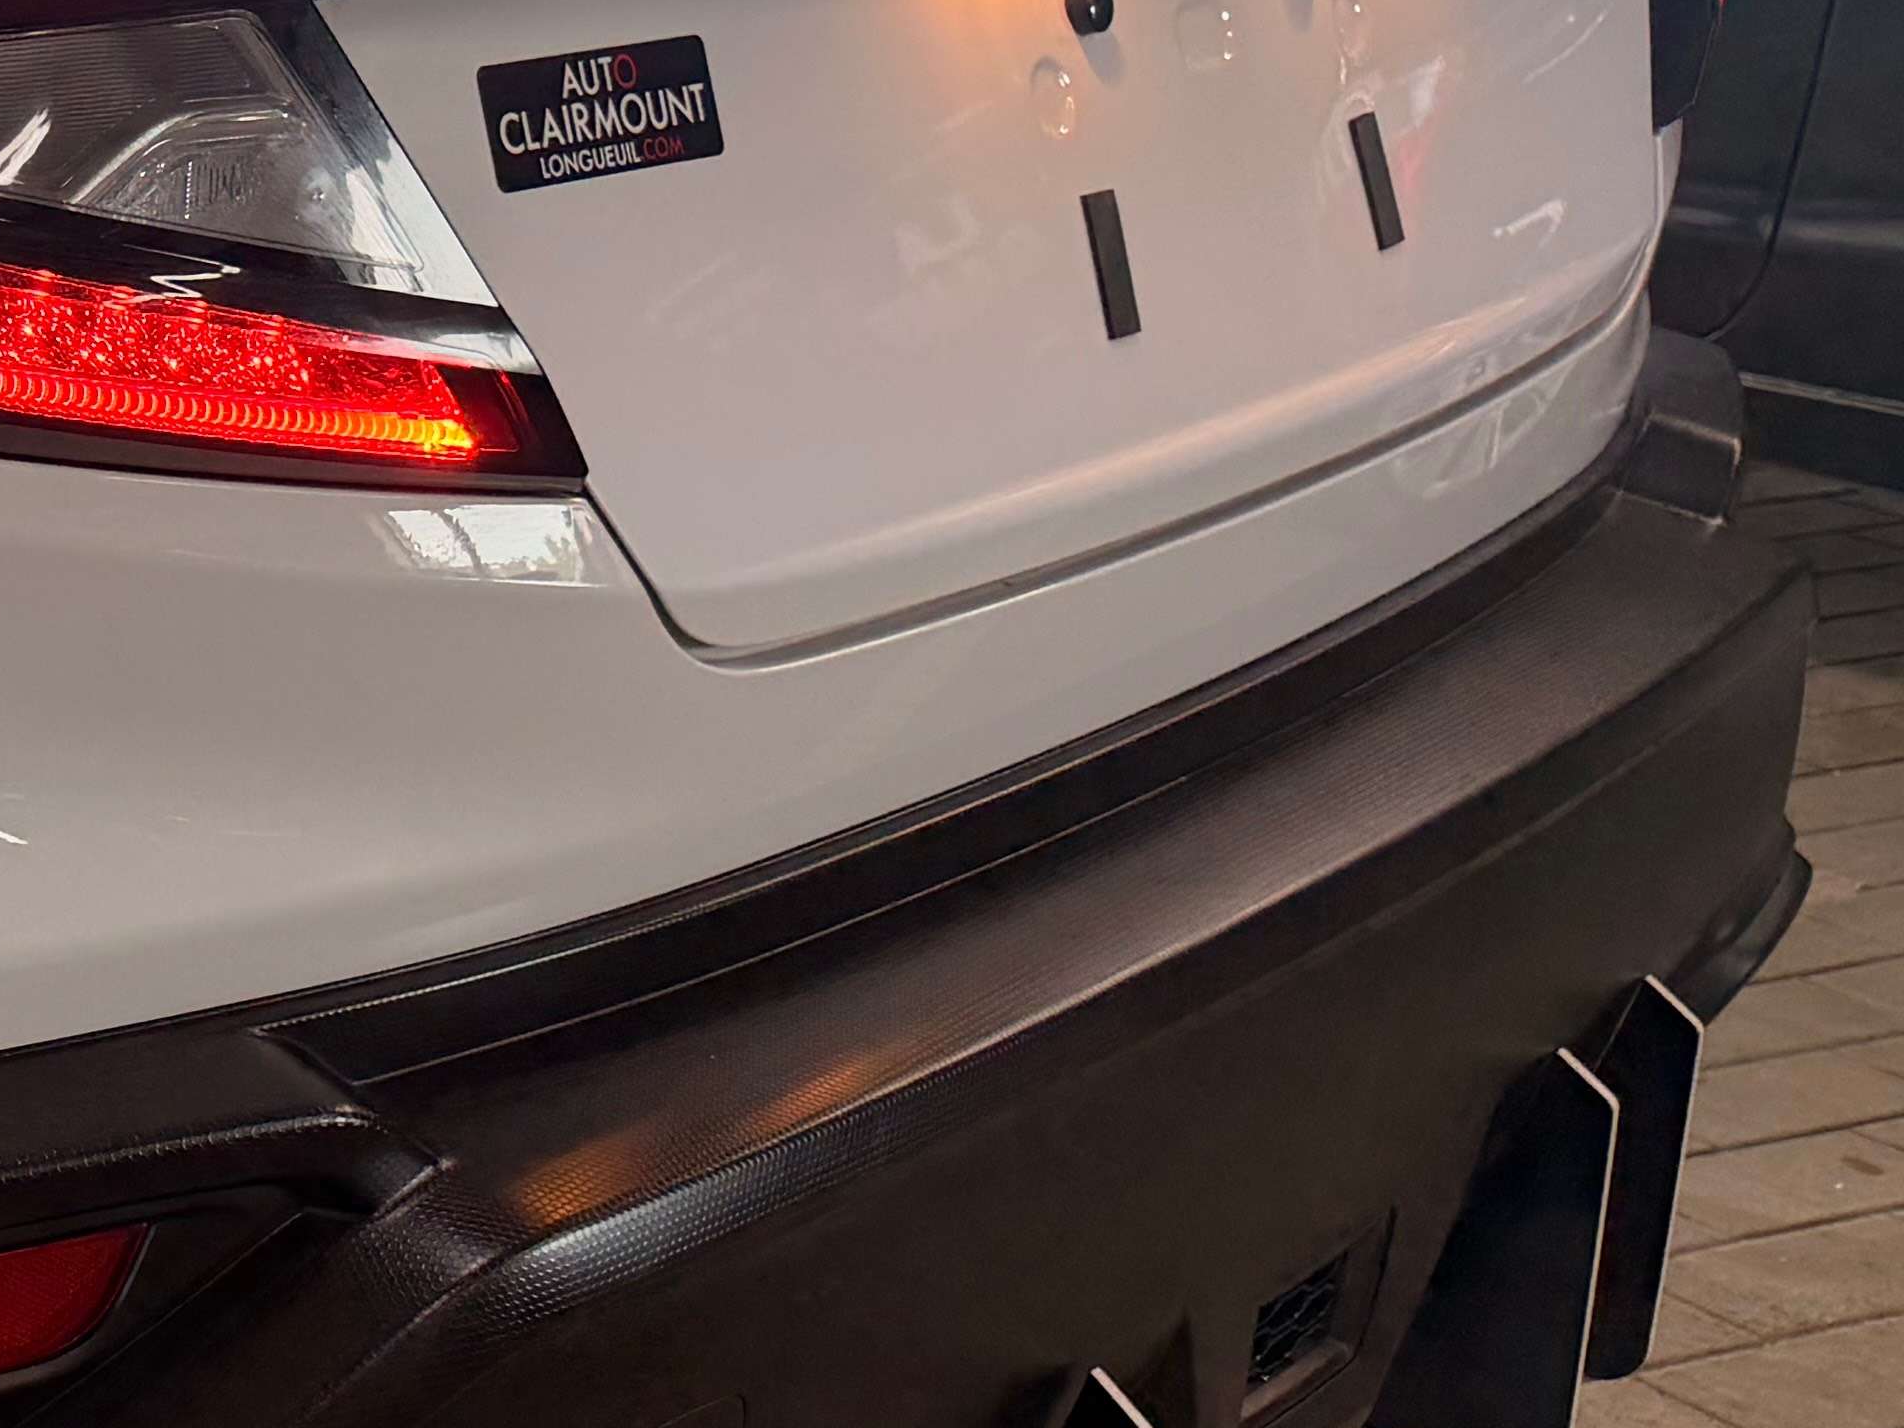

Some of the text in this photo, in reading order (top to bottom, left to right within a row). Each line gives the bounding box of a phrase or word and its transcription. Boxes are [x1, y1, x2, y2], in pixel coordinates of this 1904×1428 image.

[563, 54, 638, 99] AUTO
[499, 83, 706, 155] CLAIRMOUNT
[541, 138, 685, 179] LONGUEUIL.COM
